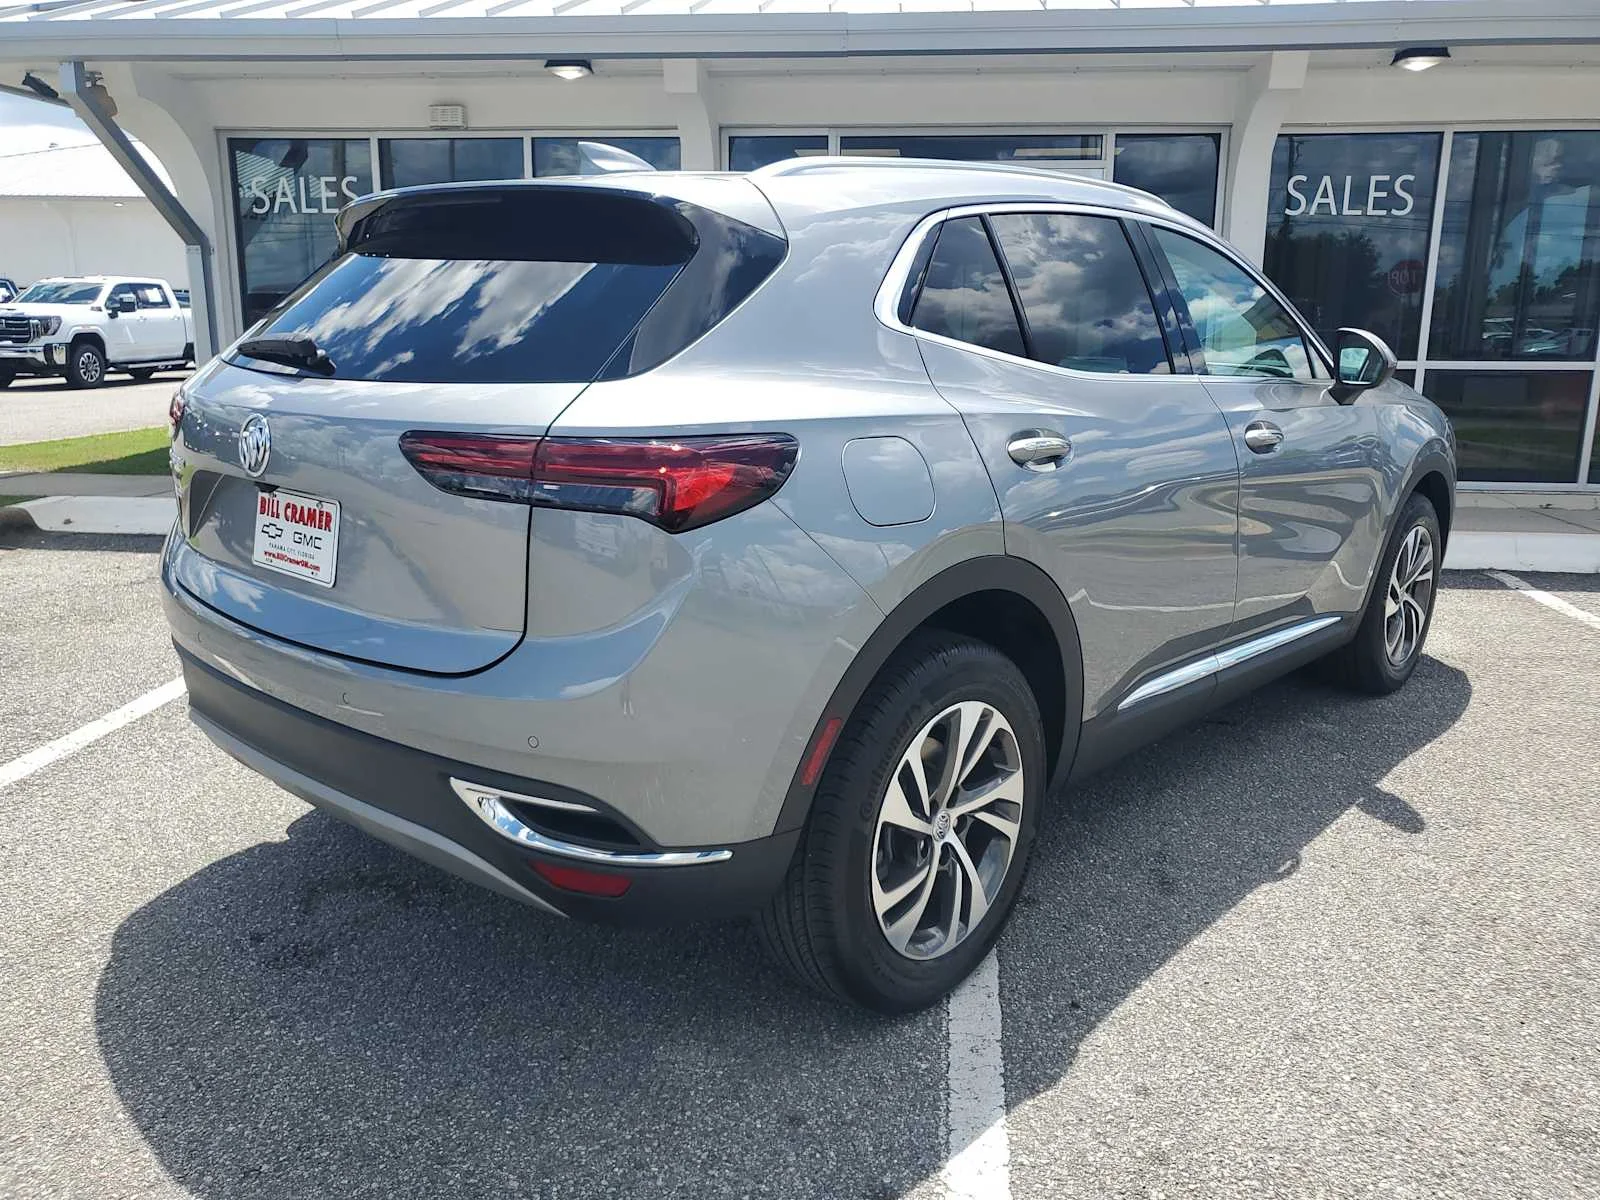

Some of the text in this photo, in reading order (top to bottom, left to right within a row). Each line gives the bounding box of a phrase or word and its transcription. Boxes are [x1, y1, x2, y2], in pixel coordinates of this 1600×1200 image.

[1284, 174, 1416, 216] SALES
[259, 495, 333, 533] BILL CRAMER
[293, 531, 323, 550] GMC
